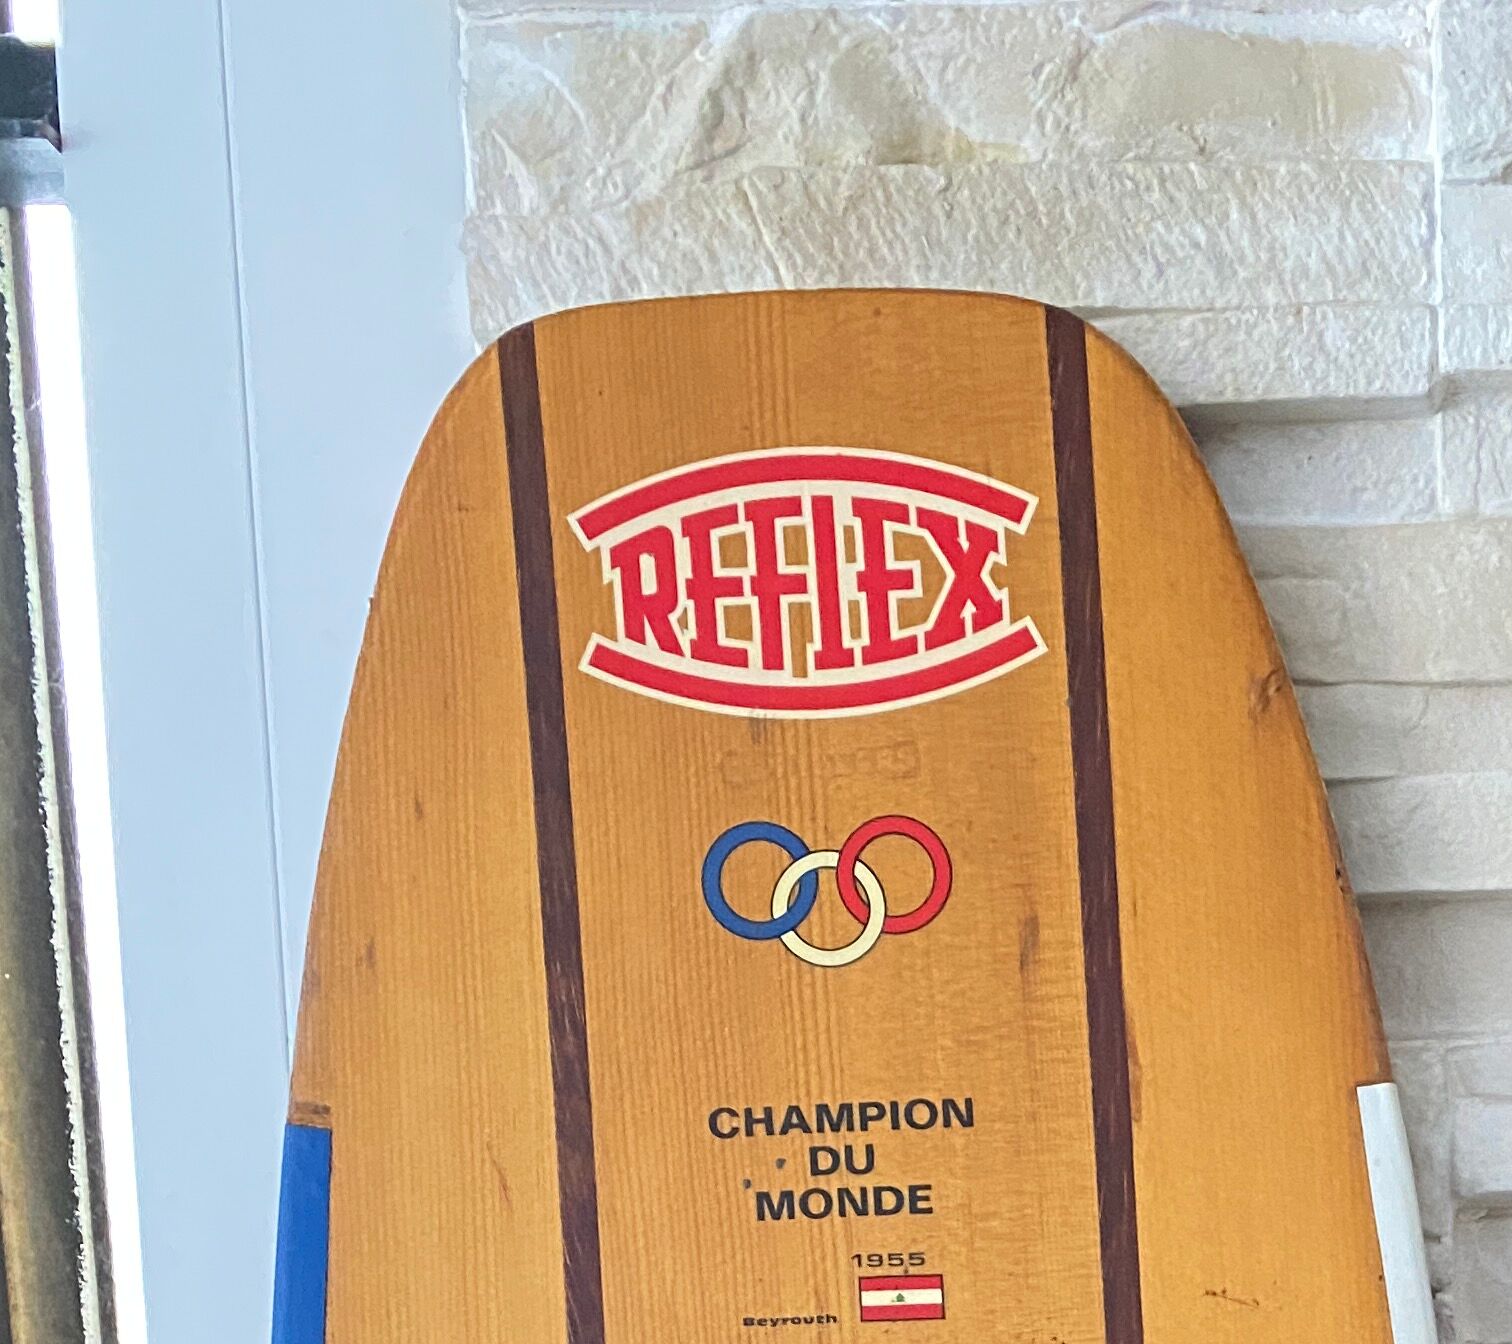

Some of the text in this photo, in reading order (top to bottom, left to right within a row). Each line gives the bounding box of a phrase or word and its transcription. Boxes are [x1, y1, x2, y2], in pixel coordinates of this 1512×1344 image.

[607, 494, 1003, 672] REFLEX
[708, 1097, 975, 1139] CHAMPION
[809, 1144, 876, 1177] DU
[755, 1184, 934, 1222] MONDE
[851, 1252, 926, 1268] 1955
[743, 1313, 838, 1328] Beyrouth
